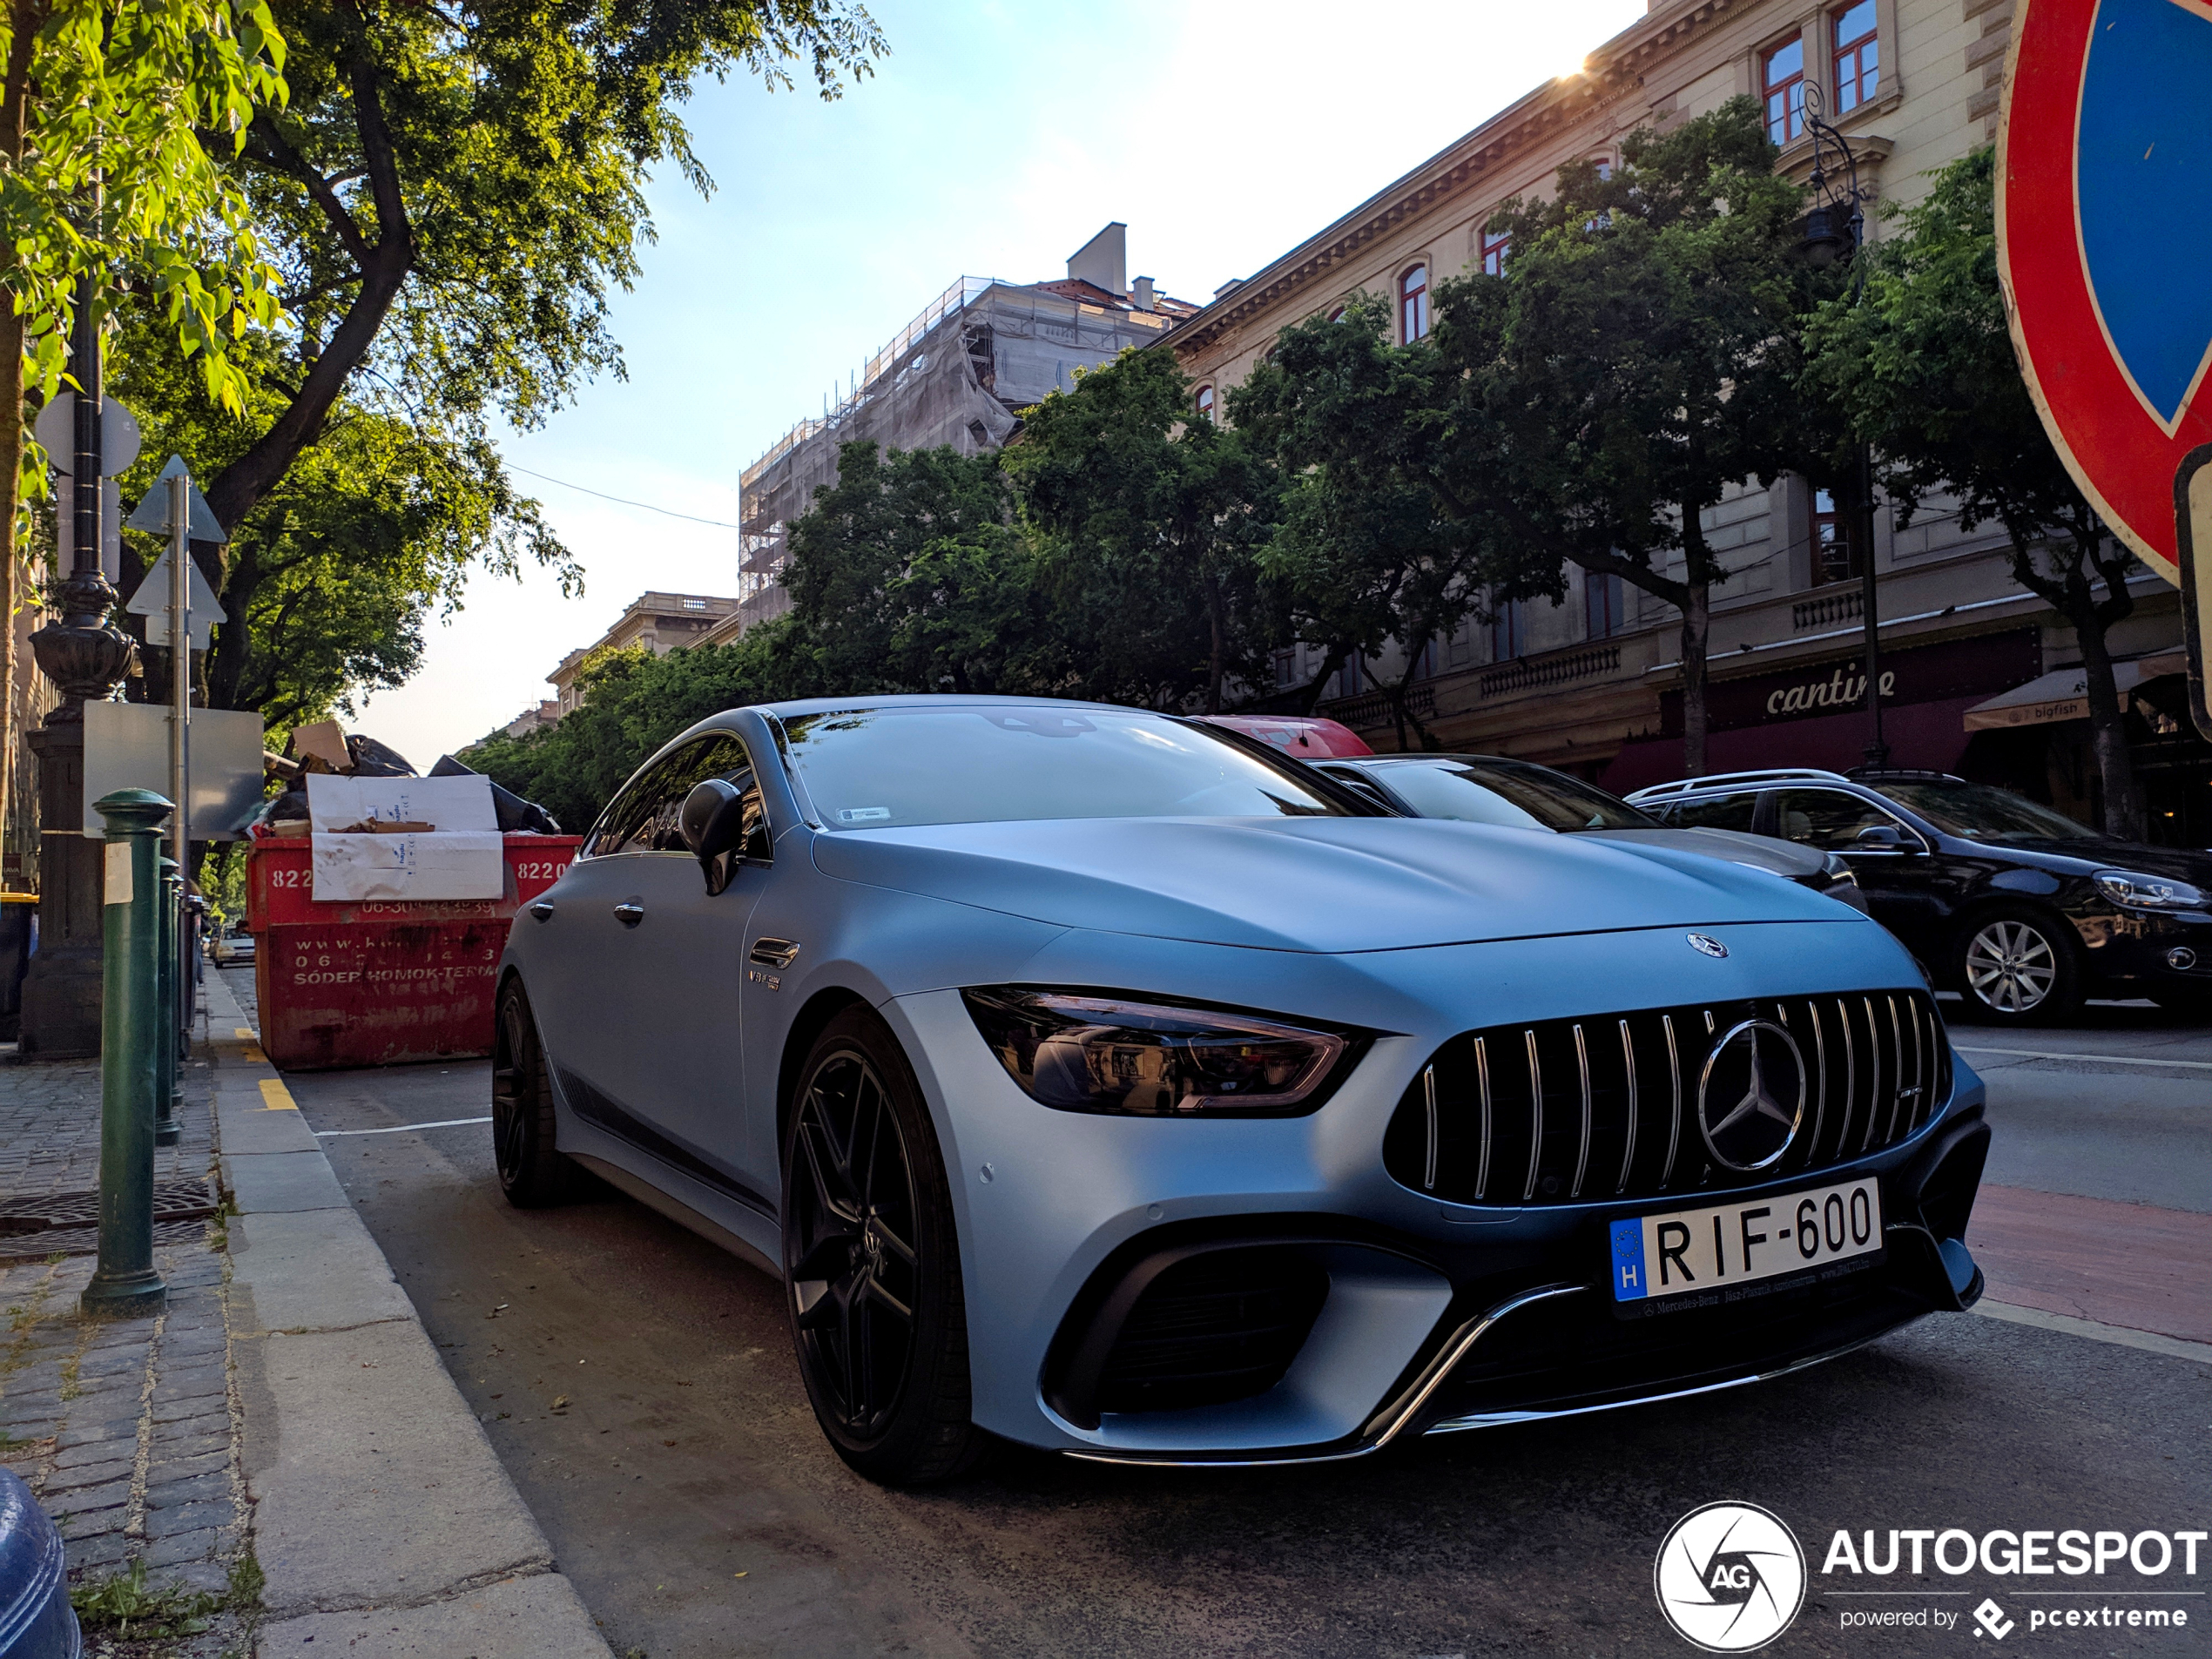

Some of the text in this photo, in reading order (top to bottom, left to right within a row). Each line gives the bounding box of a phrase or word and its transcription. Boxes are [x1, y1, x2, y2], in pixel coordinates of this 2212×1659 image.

[2035, 704, 2078, 719] bigfish
[518, 862, 566, 879] 8220
[1657, 1186, 1871, 1286] RIF-600
[1621, 1264, 1638, 1288] H
[1657, 1295, 1719, 1315] Mercedes-Benz
